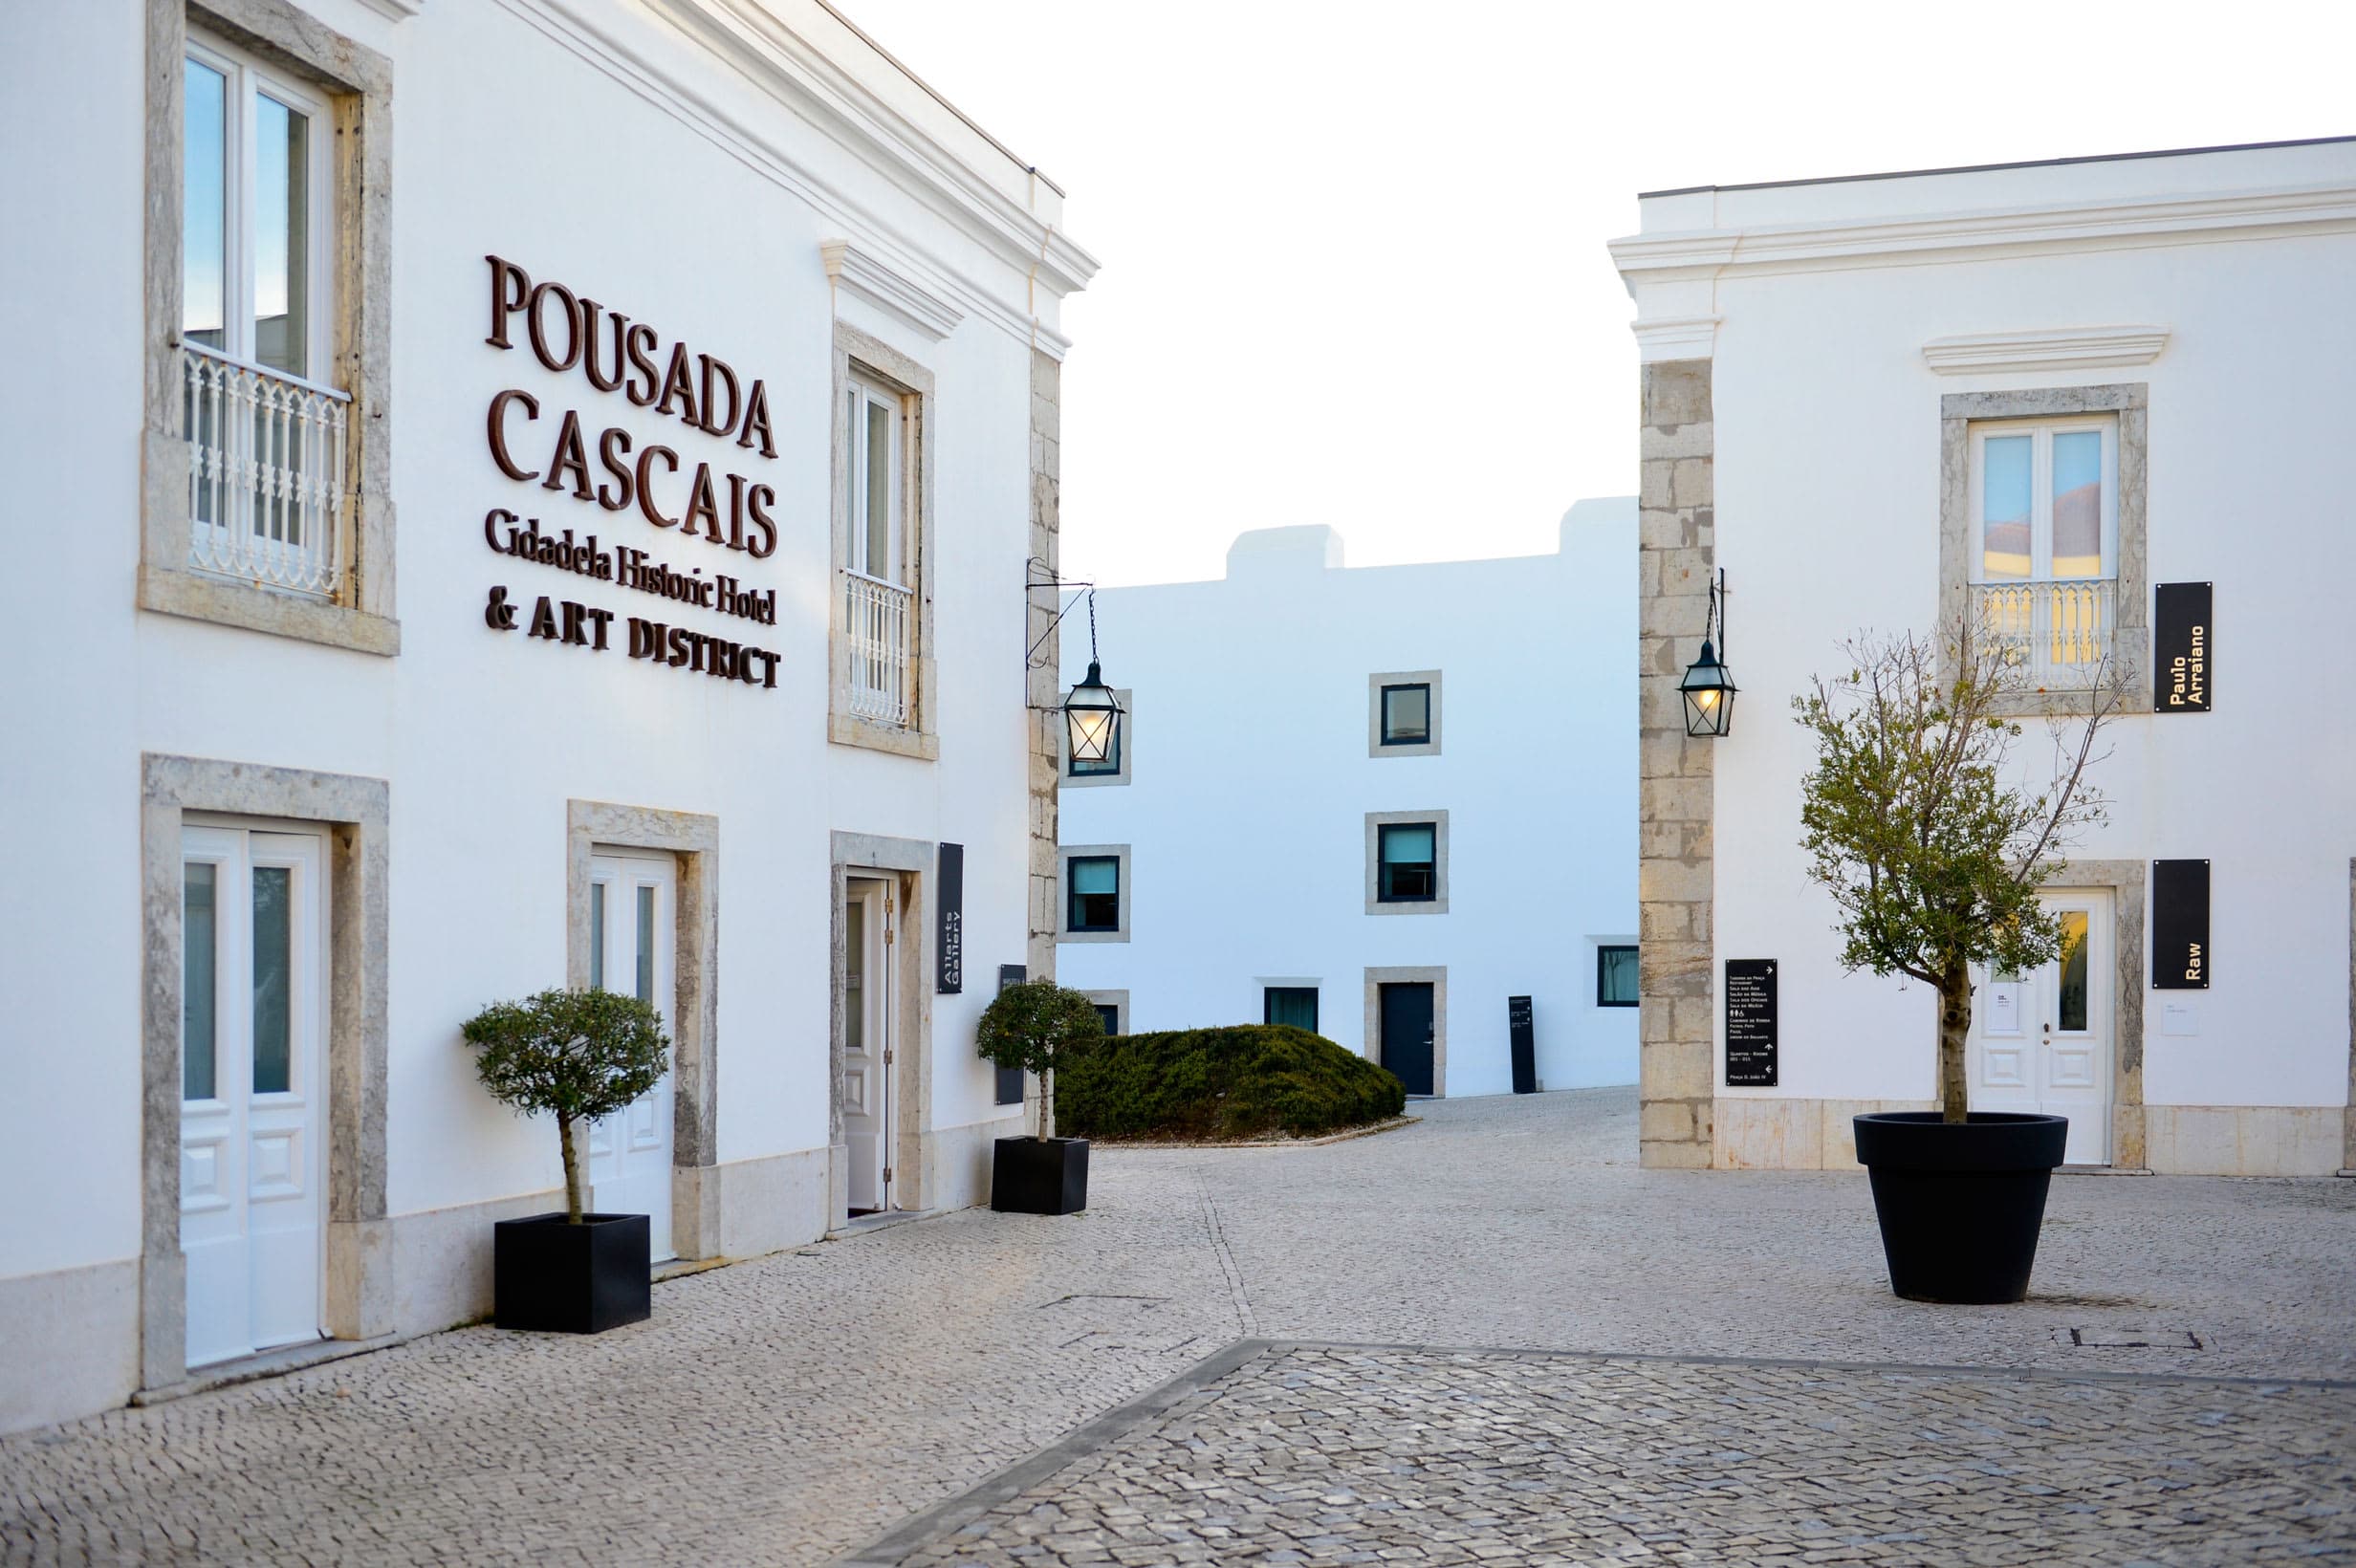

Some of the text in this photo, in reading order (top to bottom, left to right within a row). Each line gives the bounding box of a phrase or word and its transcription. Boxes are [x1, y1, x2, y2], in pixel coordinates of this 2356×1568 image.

[484, 254, 779, 459] POUSADA
[486, 389, 778, 559] CASCAIS
[484, 508, 778, 625] Cidadela Historic Hotel
[485, 584, 782, 688] & ART DISTRICT
[2170, 656, 2186, 706] Paulo
[2188, 625, 2204, 705] Arraiano
[951, 910, 961, 985] Gallery
[2185, 943, 2201, 980] Raw
